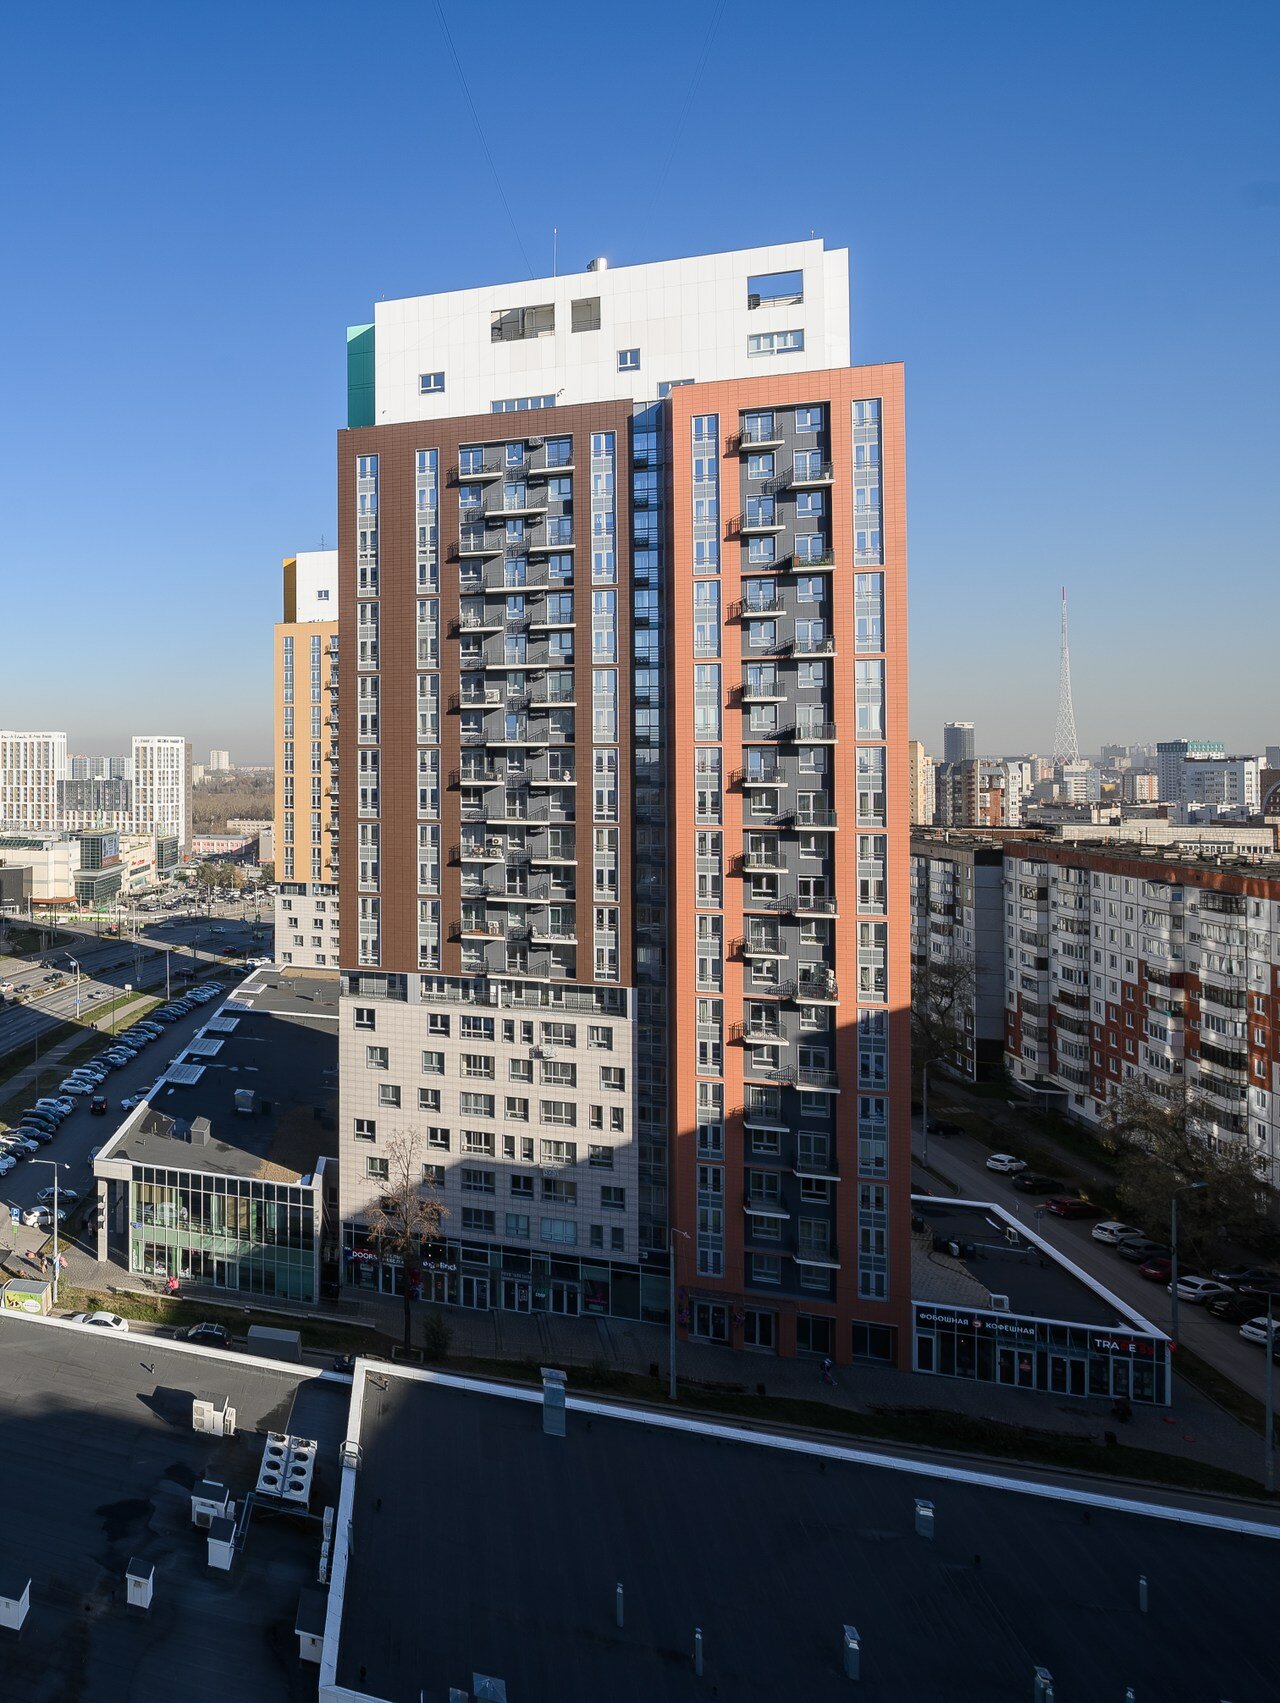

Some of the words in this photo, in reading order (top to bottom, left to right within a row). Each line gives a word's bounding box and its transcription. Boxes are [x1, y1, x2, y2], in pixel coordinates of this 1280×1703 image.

[352, 1250, 378, 1260] DOORS
[919, 1312, 969, 1326] ФОБОШНАЯ
[985, 1322, 1035, 1335] КОФЕШНАЯ
